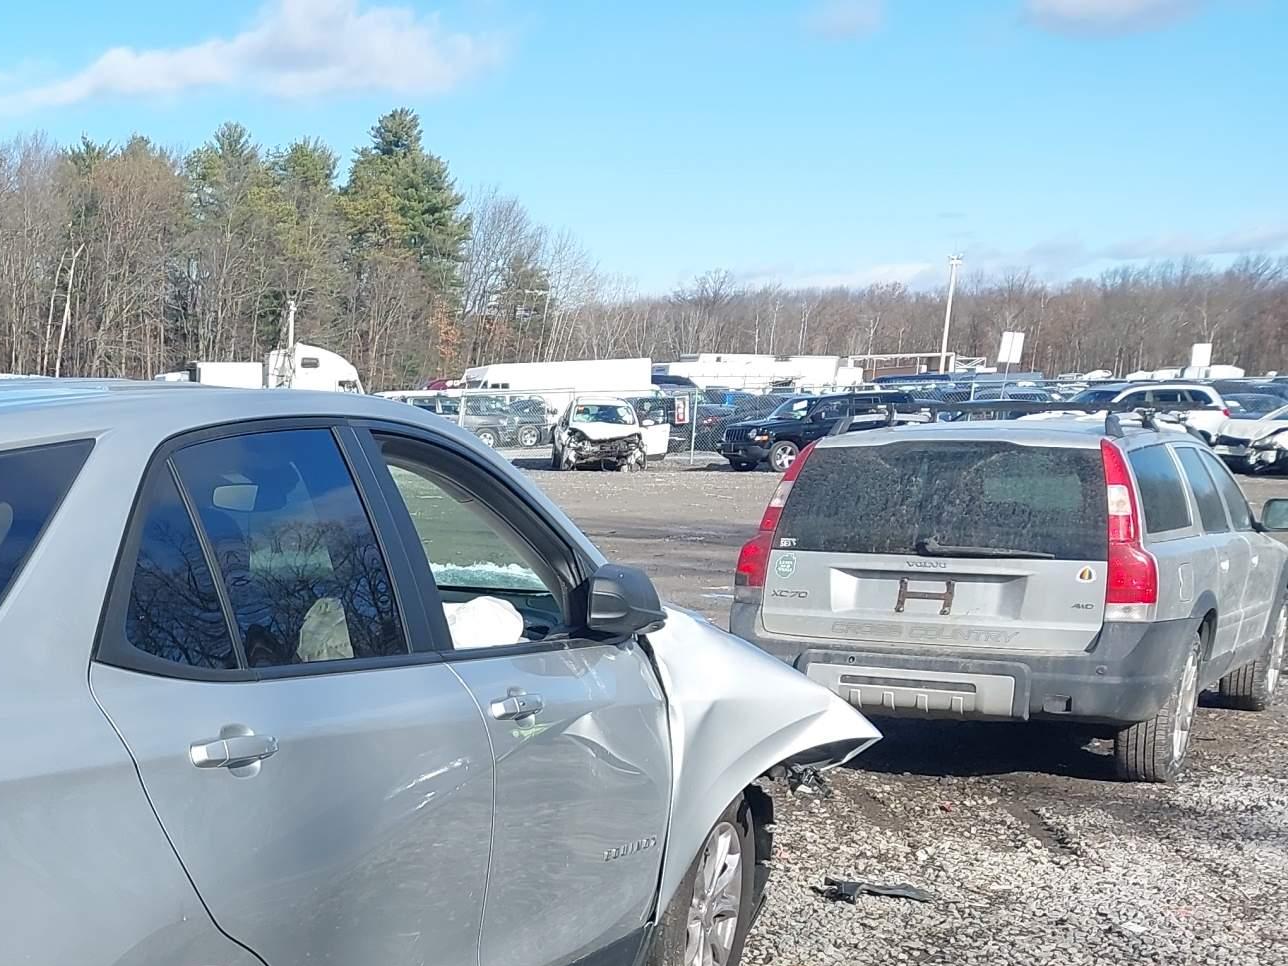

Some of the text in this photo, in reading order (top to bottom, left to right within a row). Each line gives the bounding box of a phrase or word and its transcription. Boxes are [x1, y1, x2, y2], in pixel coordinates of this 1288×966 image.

[905, 560, 947, 569] VOLVO
[831, 621, 1021, 643] CROSS COUNTRY
